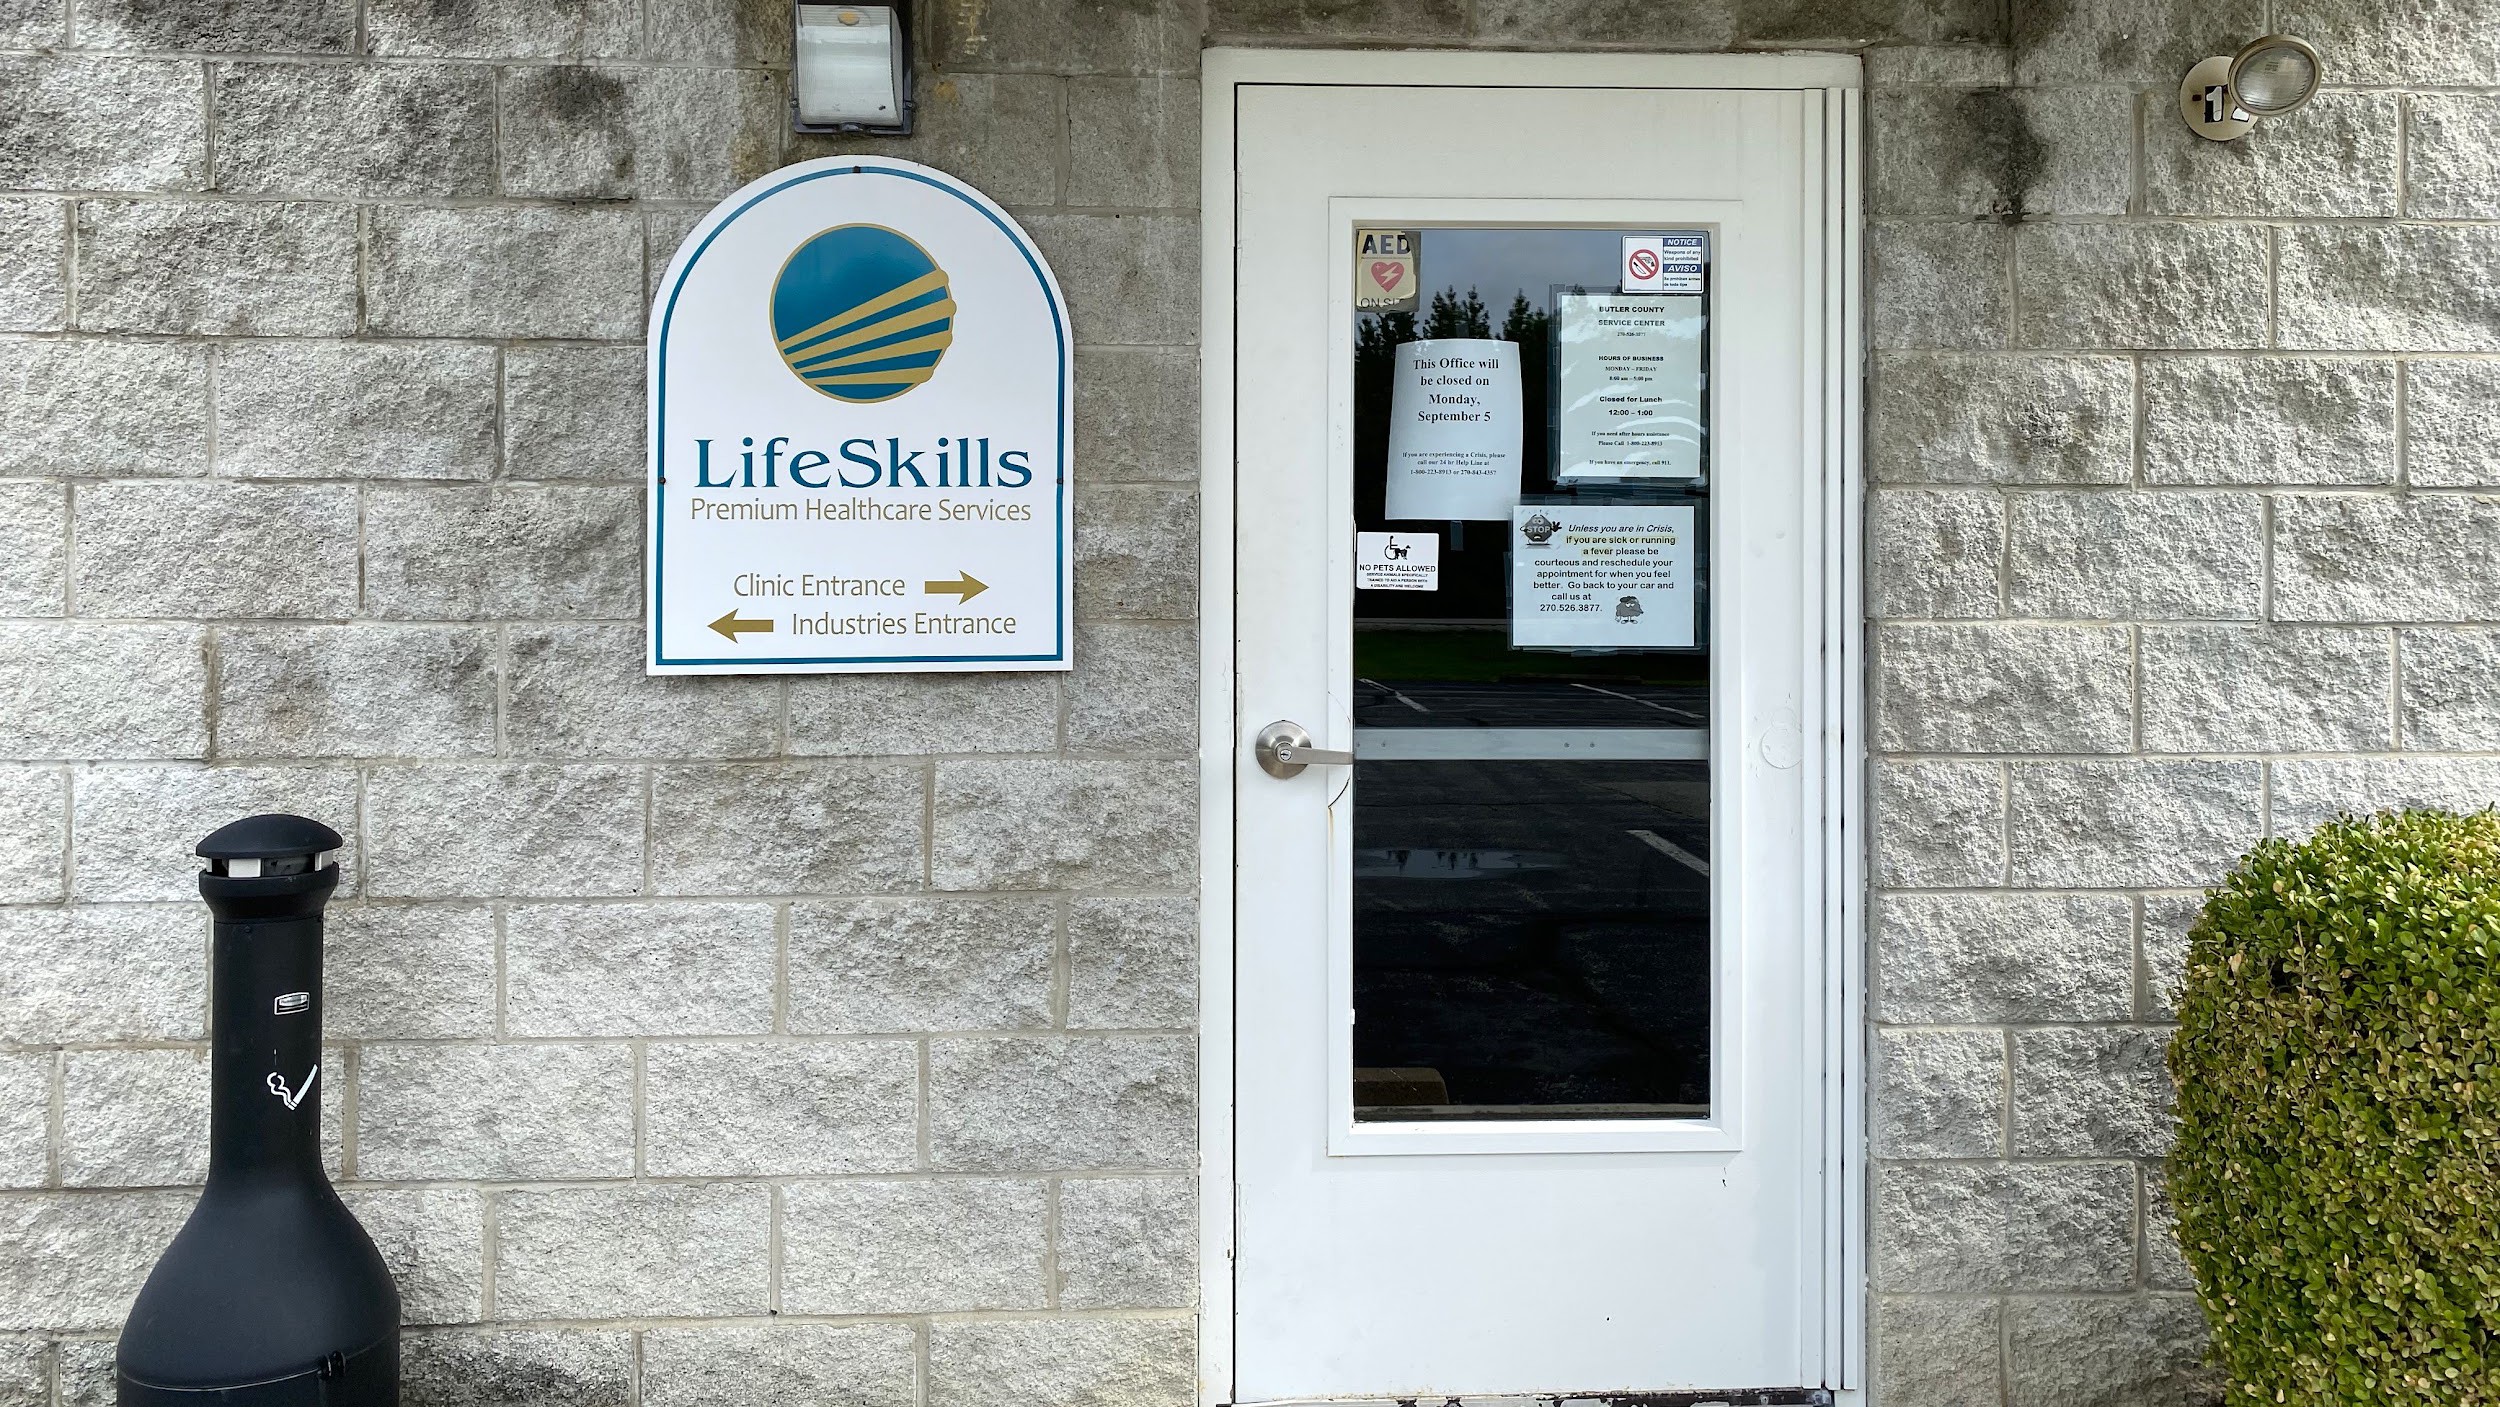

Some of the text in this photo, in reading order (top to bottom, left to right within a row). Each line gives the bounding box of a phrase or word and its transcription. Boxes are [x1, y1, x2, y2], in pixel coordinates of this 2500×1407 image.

[2205, 86, 2250, 122] 1
[1362, 235, 1410, 254] AED
[1360, 298, 1380, 308] ON
[1413, 358, 1499, 370] This Office will
[1420, 376, 1433, 386] be
[1436, 375, 1472, 385] closed
[1429, 394, 1481, 406] Monday,
[1418, 411, 1491, 423] September 5
[694, 436, 1032, 488] LifeSkills
[691, 497, 1032, 521] Premium Healthcare Services
[1646, 525, 1675, 533] Crisis,
[1641, 536, 1676, 545] running
[1615, 548, 1645, 556] please
[1536, 570, 1593, 579] appointment
[734, 573, 906, 597] Clinic Entrance
[792, 612, 1017, 635] Industries Entrance
